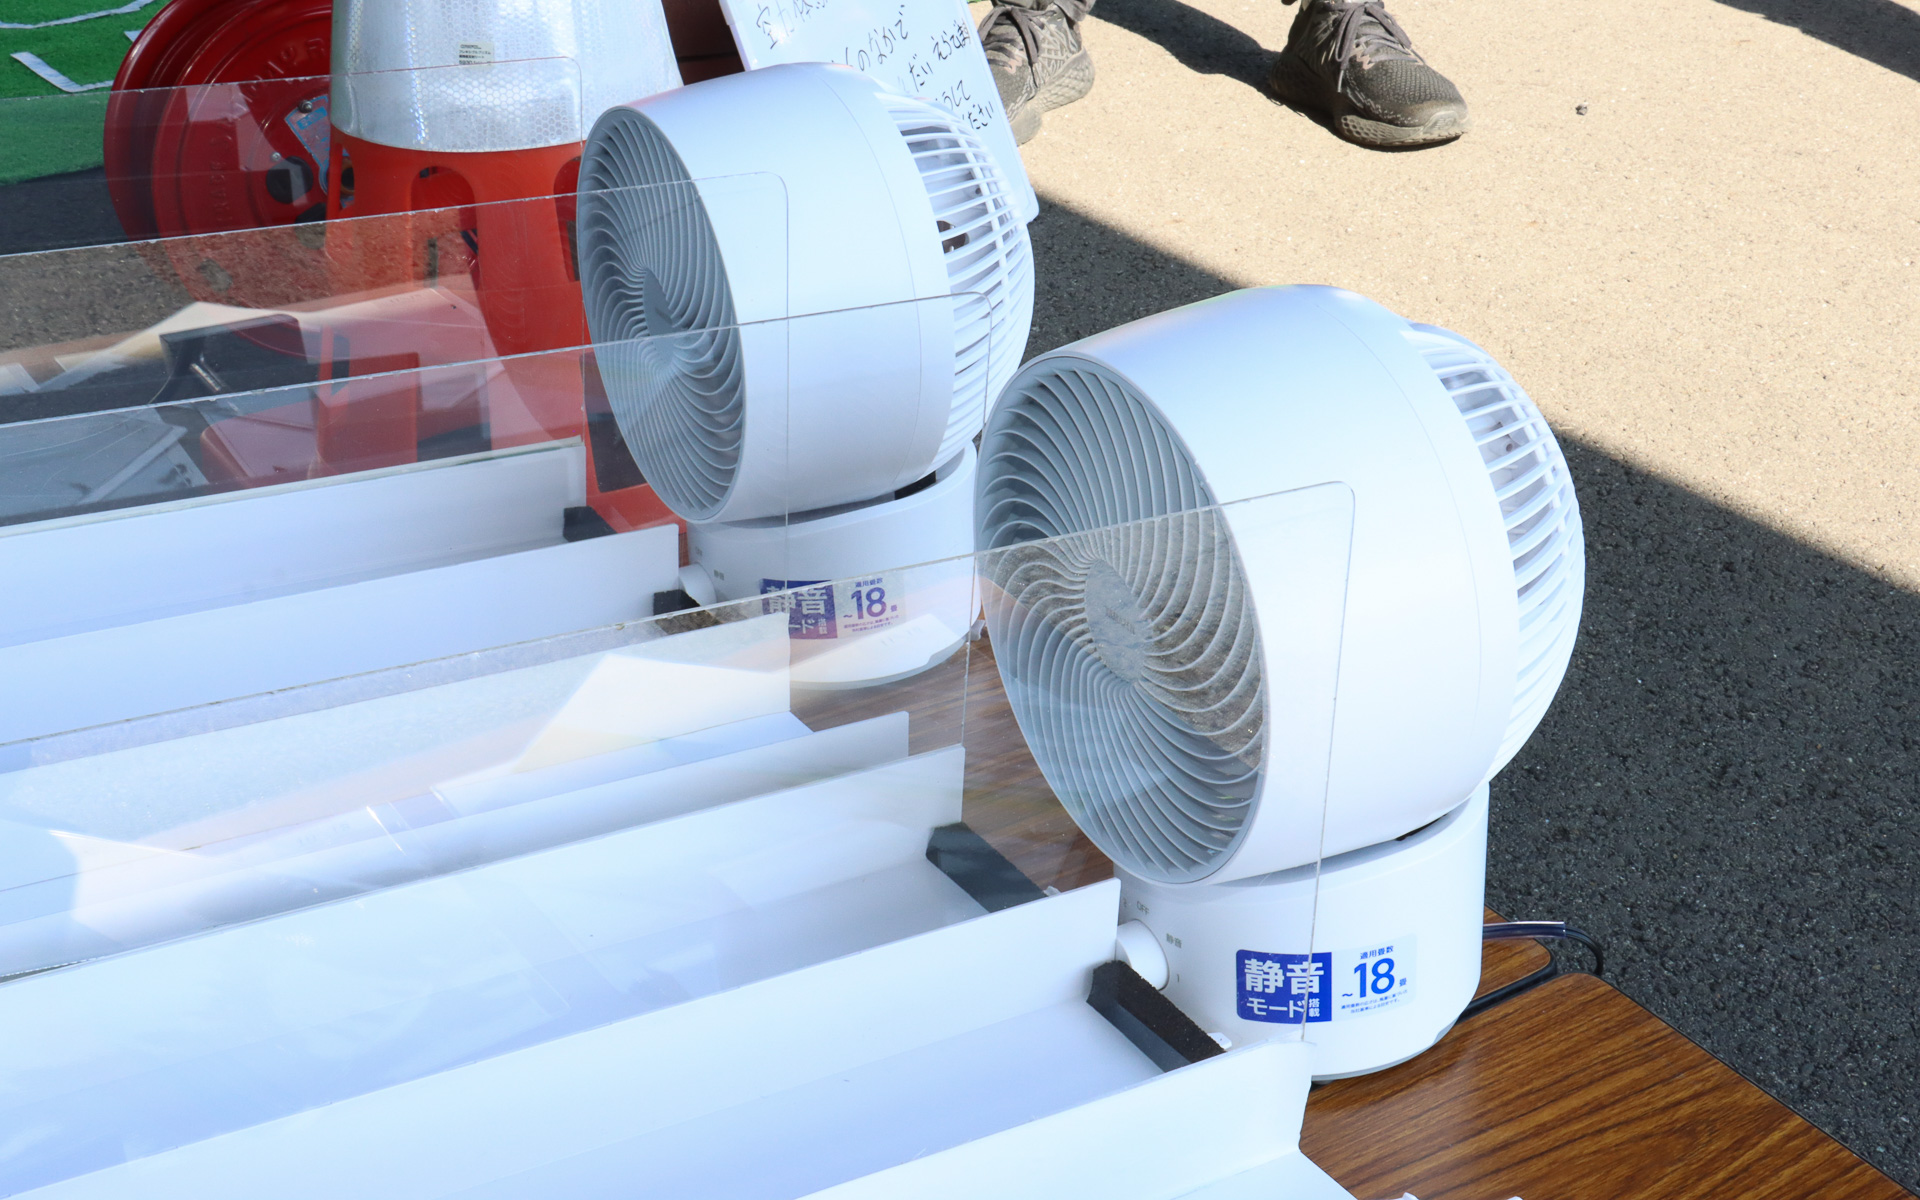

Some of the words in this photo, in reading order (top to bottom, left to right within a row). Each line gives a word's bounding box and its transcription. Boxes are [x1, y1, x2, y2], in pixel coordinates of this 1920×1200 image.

[766, 585, 828, 615] 静音
[1360, 945, 1394, 960] 適用畳数
[1244, 958, 1325, 995] 静音
[1246, 997, 1307, 1019] モード
[1308, 997, 1321, 1018] 搭載
